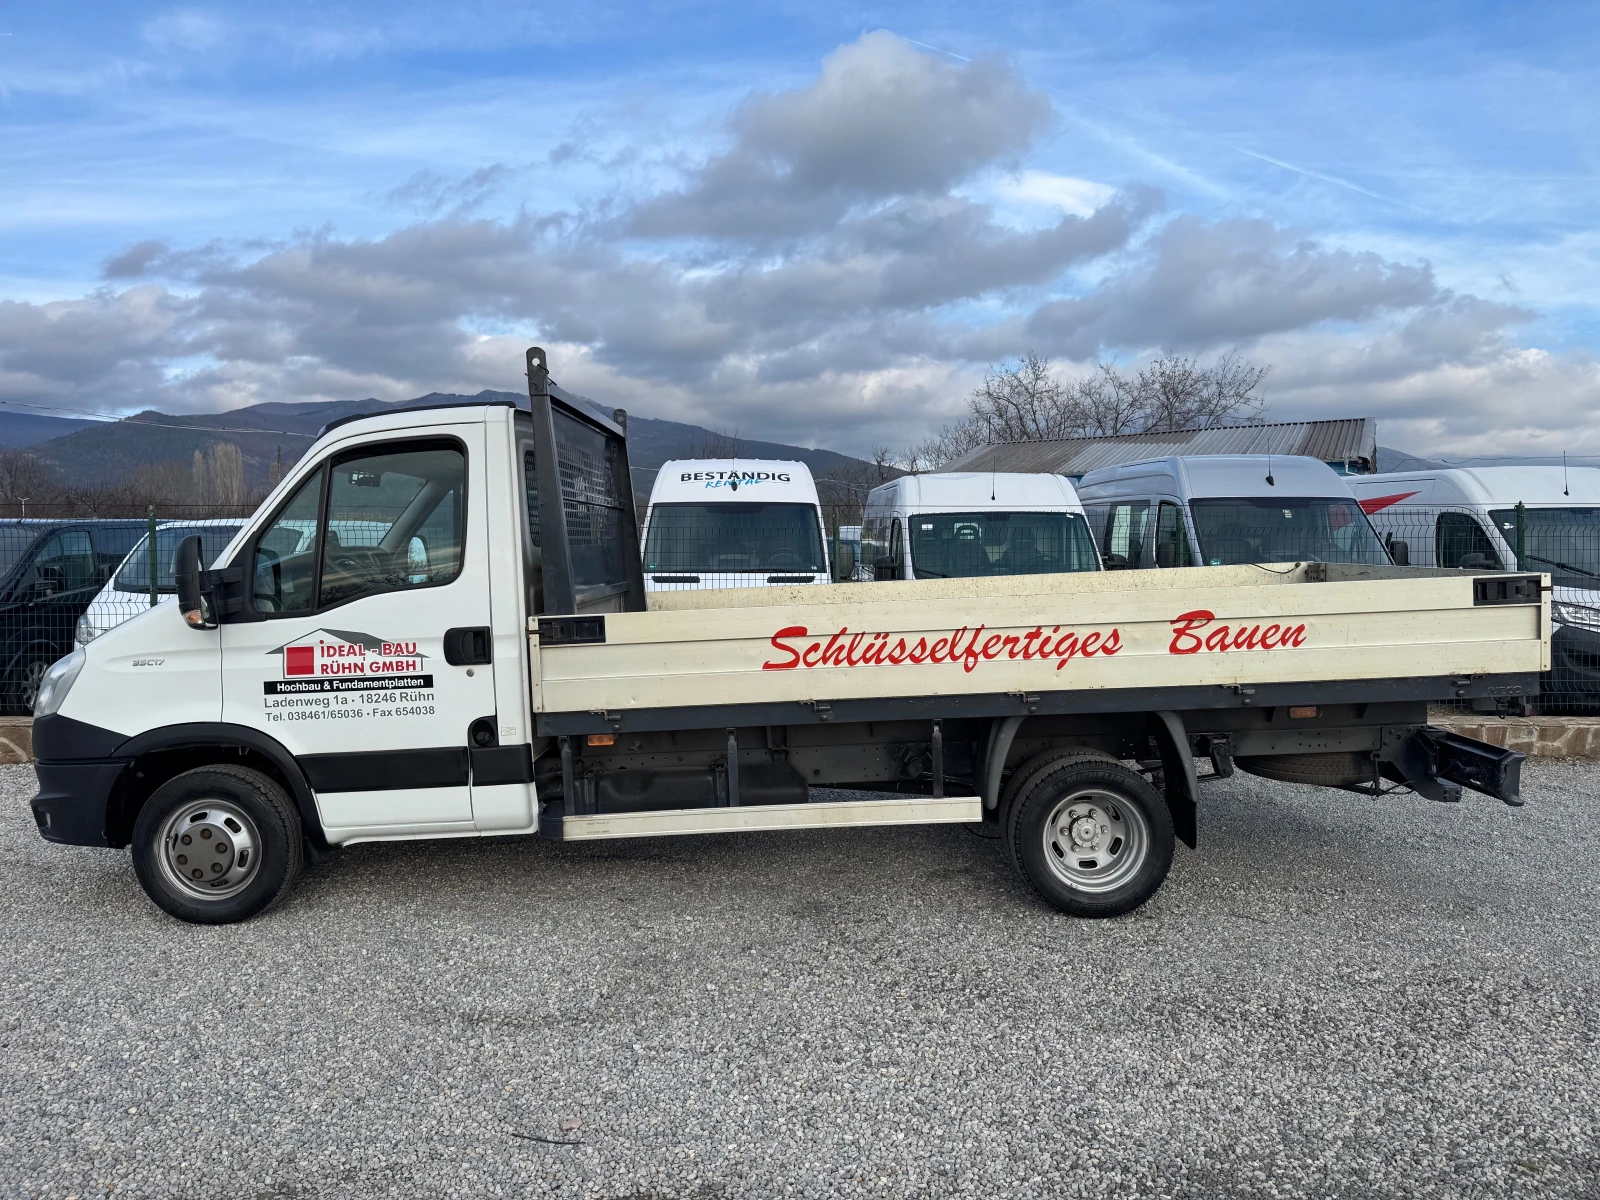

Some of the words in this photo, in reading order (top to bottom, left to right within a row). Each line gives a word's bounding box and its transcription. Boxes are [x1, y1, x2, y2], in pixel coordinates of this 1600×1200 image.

[680, 470, 791, 482] BESTÄNDIG
[705, 478, 761, 489] RENTAL
[762, 623, 1124, 673] Schlüsselfertiges
[1169, 609, 1307, 655] Bauen
[382, 642, 417, 656] BAU
[320, 660, 365, 675] RÜHN
[369, 660, 417, 673] GMBH
[277, 681, 321, 692] Hochbau
[323, 681, 331, 690] &
[333, 678, 424, 690] Fundamentplatten
[264, 696, 330, 709] Ladenweg
[333, 695, 348, 706] 1a
[358, 693, 397, 704] 18246
[400, 691, 435, 702] Rühn
[265, 712, 286, 722] Tel.
[287, 709, 364, 721] 038461/65036
[372, 708, 393, 718] Fax
[395, 706, 435, 716] 654038
[1066, 771, 1126, 785] MICHELIN
